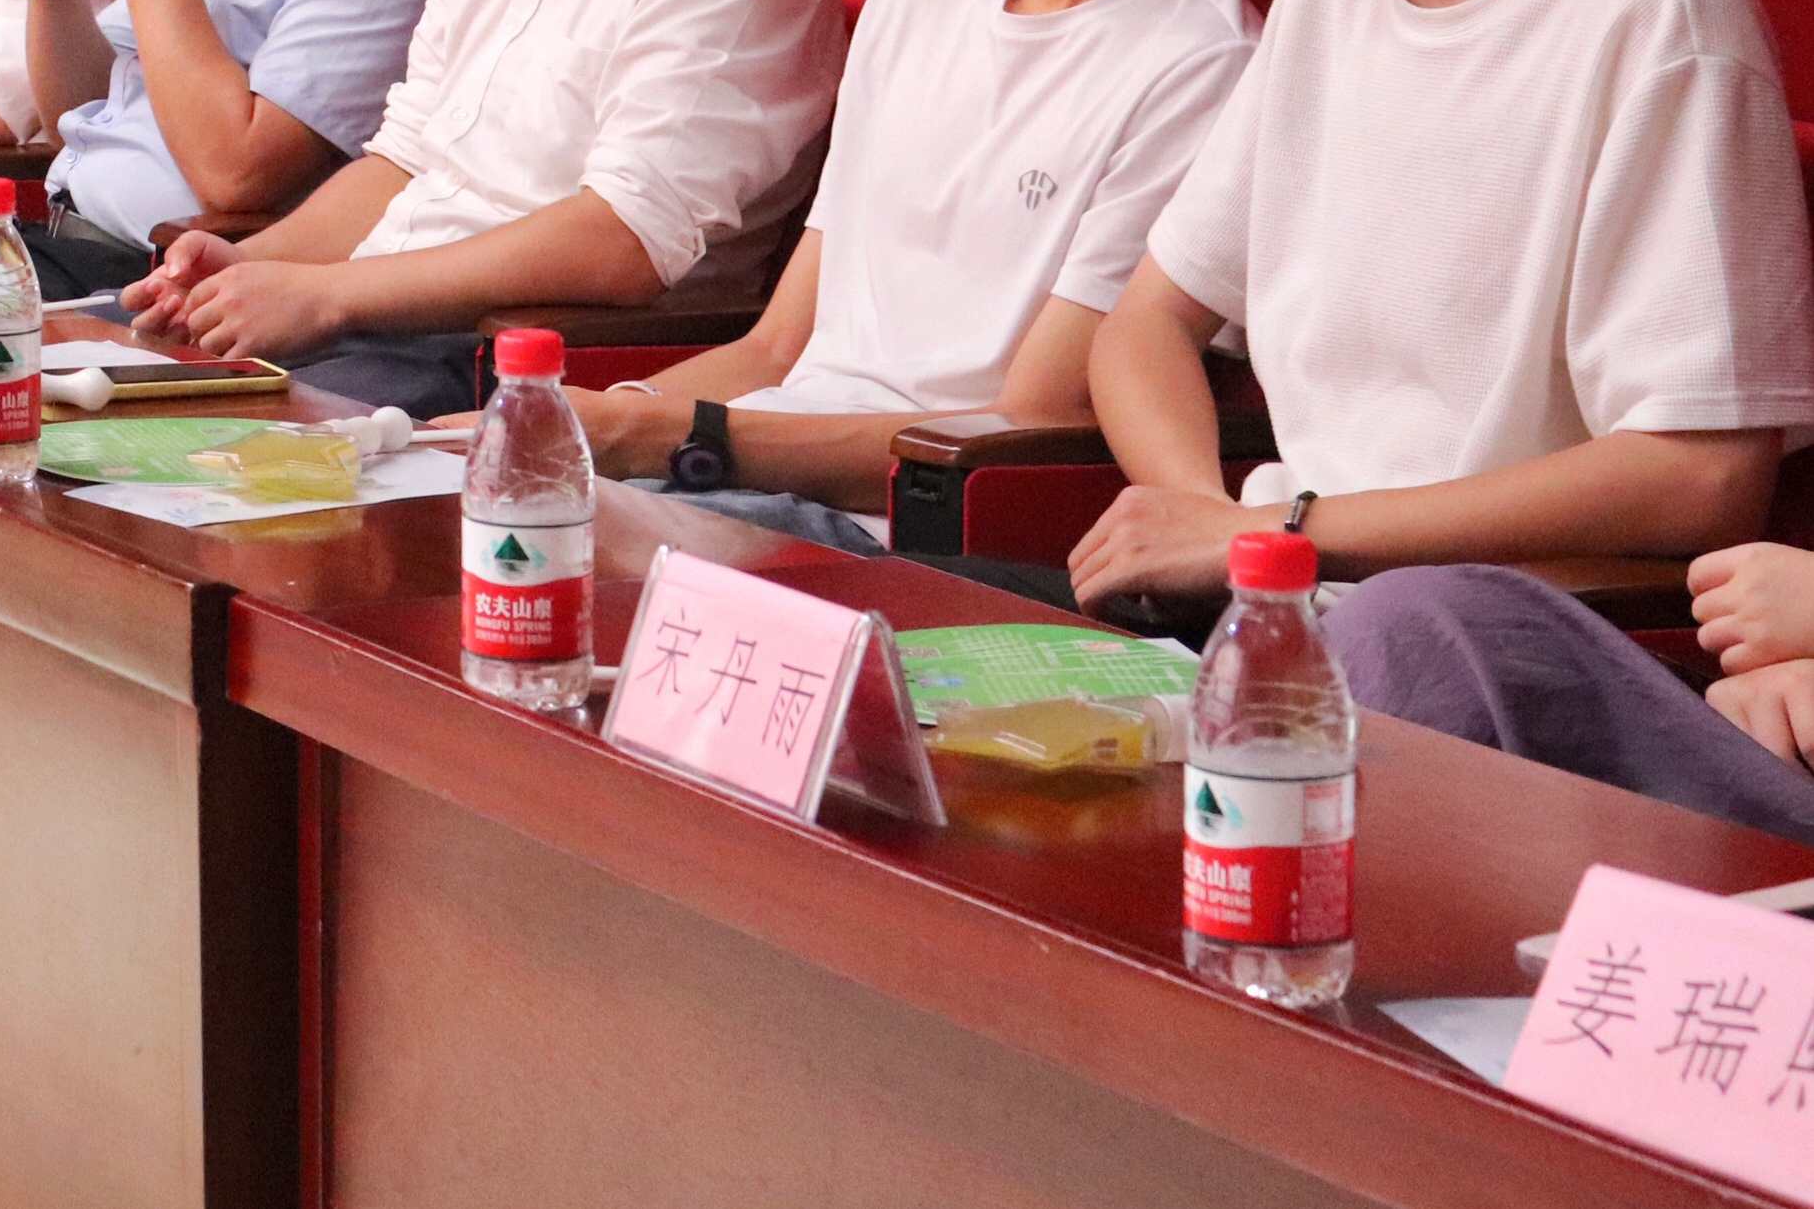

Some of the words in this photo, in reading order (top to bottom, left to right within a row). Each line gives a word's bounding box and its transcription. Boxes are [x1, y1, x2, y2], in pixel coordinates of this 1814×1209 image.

[475, 593, 552, 619] 农夫山泉
[635, 606, 826, 757] 宋丹雨
[1183, 851, 1252, 892] 夫山泉
